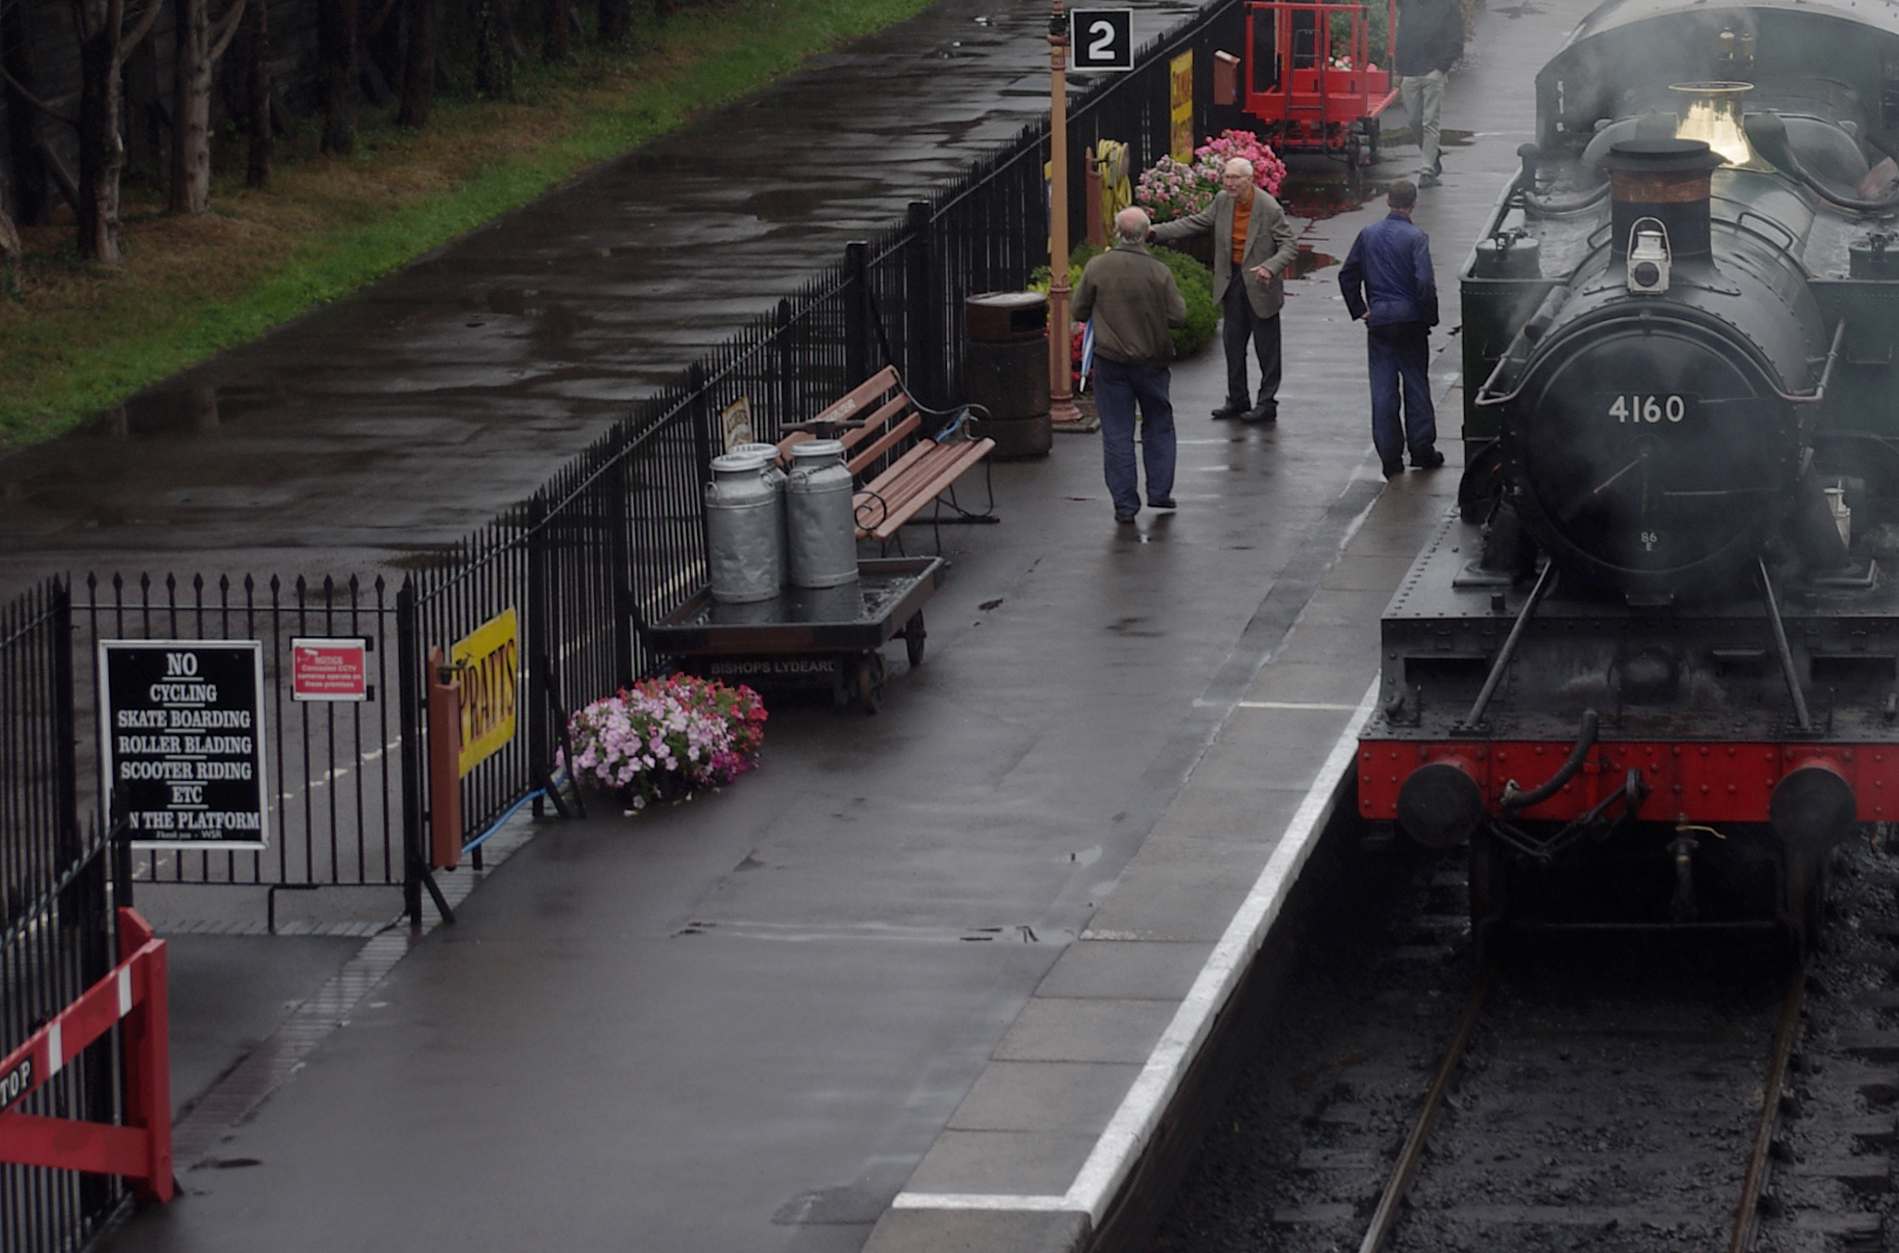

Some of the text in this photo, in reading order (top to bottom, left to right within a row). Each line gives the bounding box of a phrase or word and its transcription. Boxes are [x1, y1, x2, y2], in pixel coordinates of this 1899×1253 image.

[1088, 20, 1116, 60] 2
[1608, 395, 1685, 423] 4160
[1641, 532, 1658, 543] 86
[1646, 542, 1652, 551] E
[166, 652, 198, 676] NO
[315, 656, 343, 664] NOTICE
[712, 662, 771, 674] BISHOPS
[324, 682, 354, 690] premises
[326, 673, 351, 681] operate
[150, 684, 217, 702] CYCLING
[118, 709, 251, 728] SKATE BOARDING
[119, 735, 252, 754] ROLLER BLADING
[121, 761, 252, 780] SCOOTER RIDING
[172, 786, 203, 804] ETC
[142, 811, 175, 829] THE
[178, 811, 260, 830] PLATFORM
